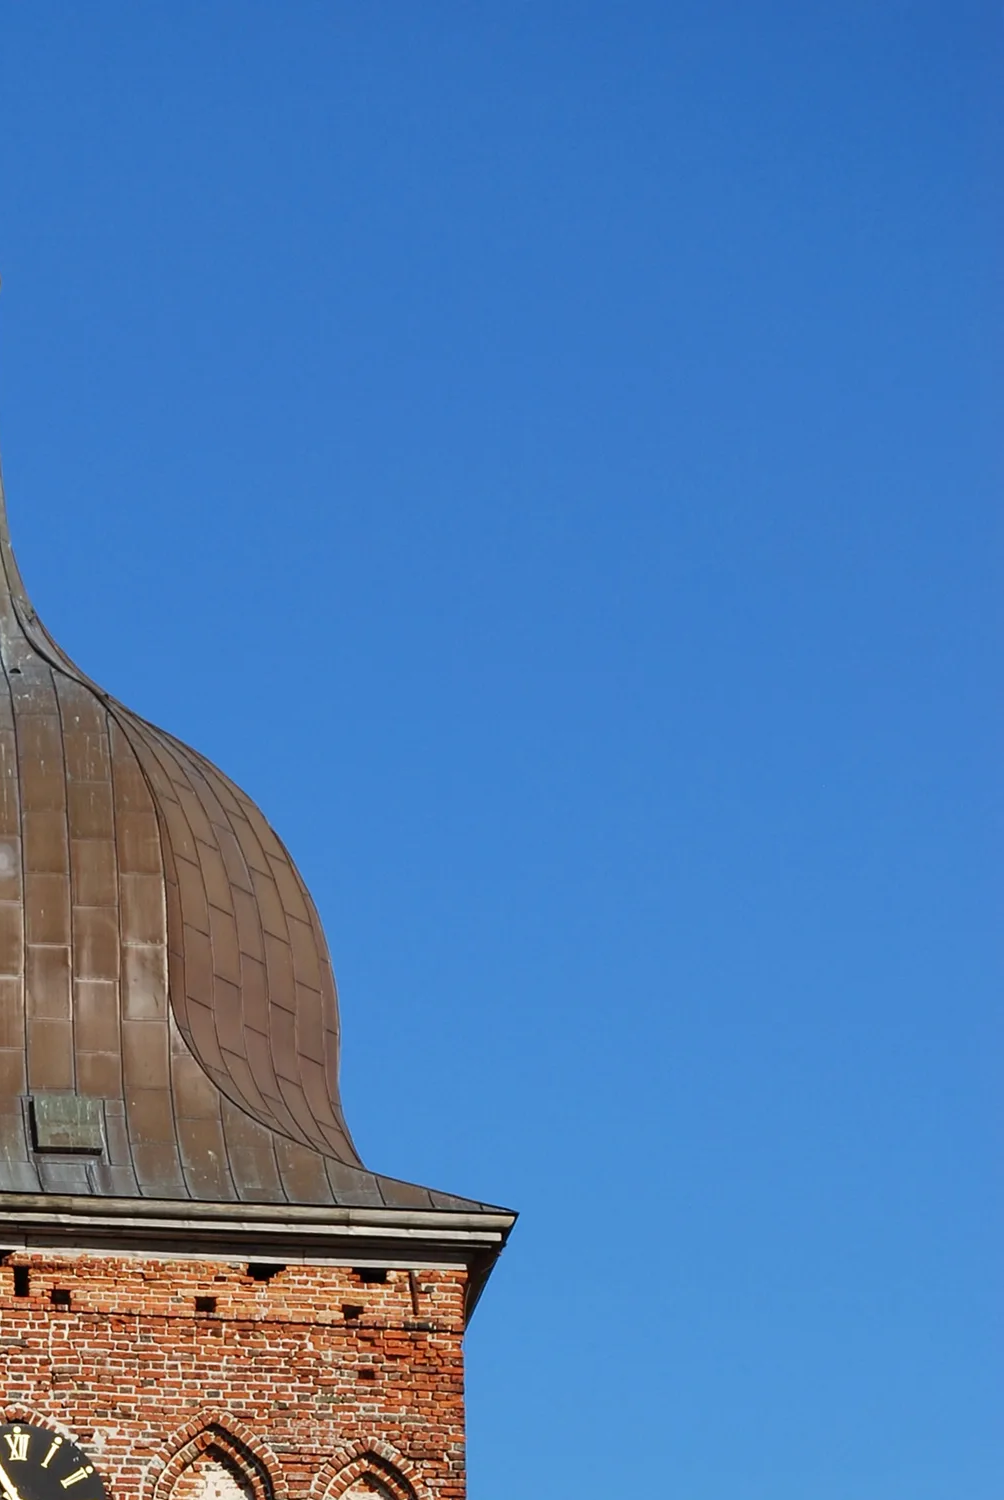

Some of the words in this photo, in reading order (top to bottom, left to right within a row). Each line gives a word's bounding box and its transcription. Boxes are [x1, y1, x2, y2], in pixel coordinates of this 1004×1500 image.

[4, 1434, 30, 1461] XII
[41, 1443, 59, 1468] I
[60, 1467, 88, 1489] II
